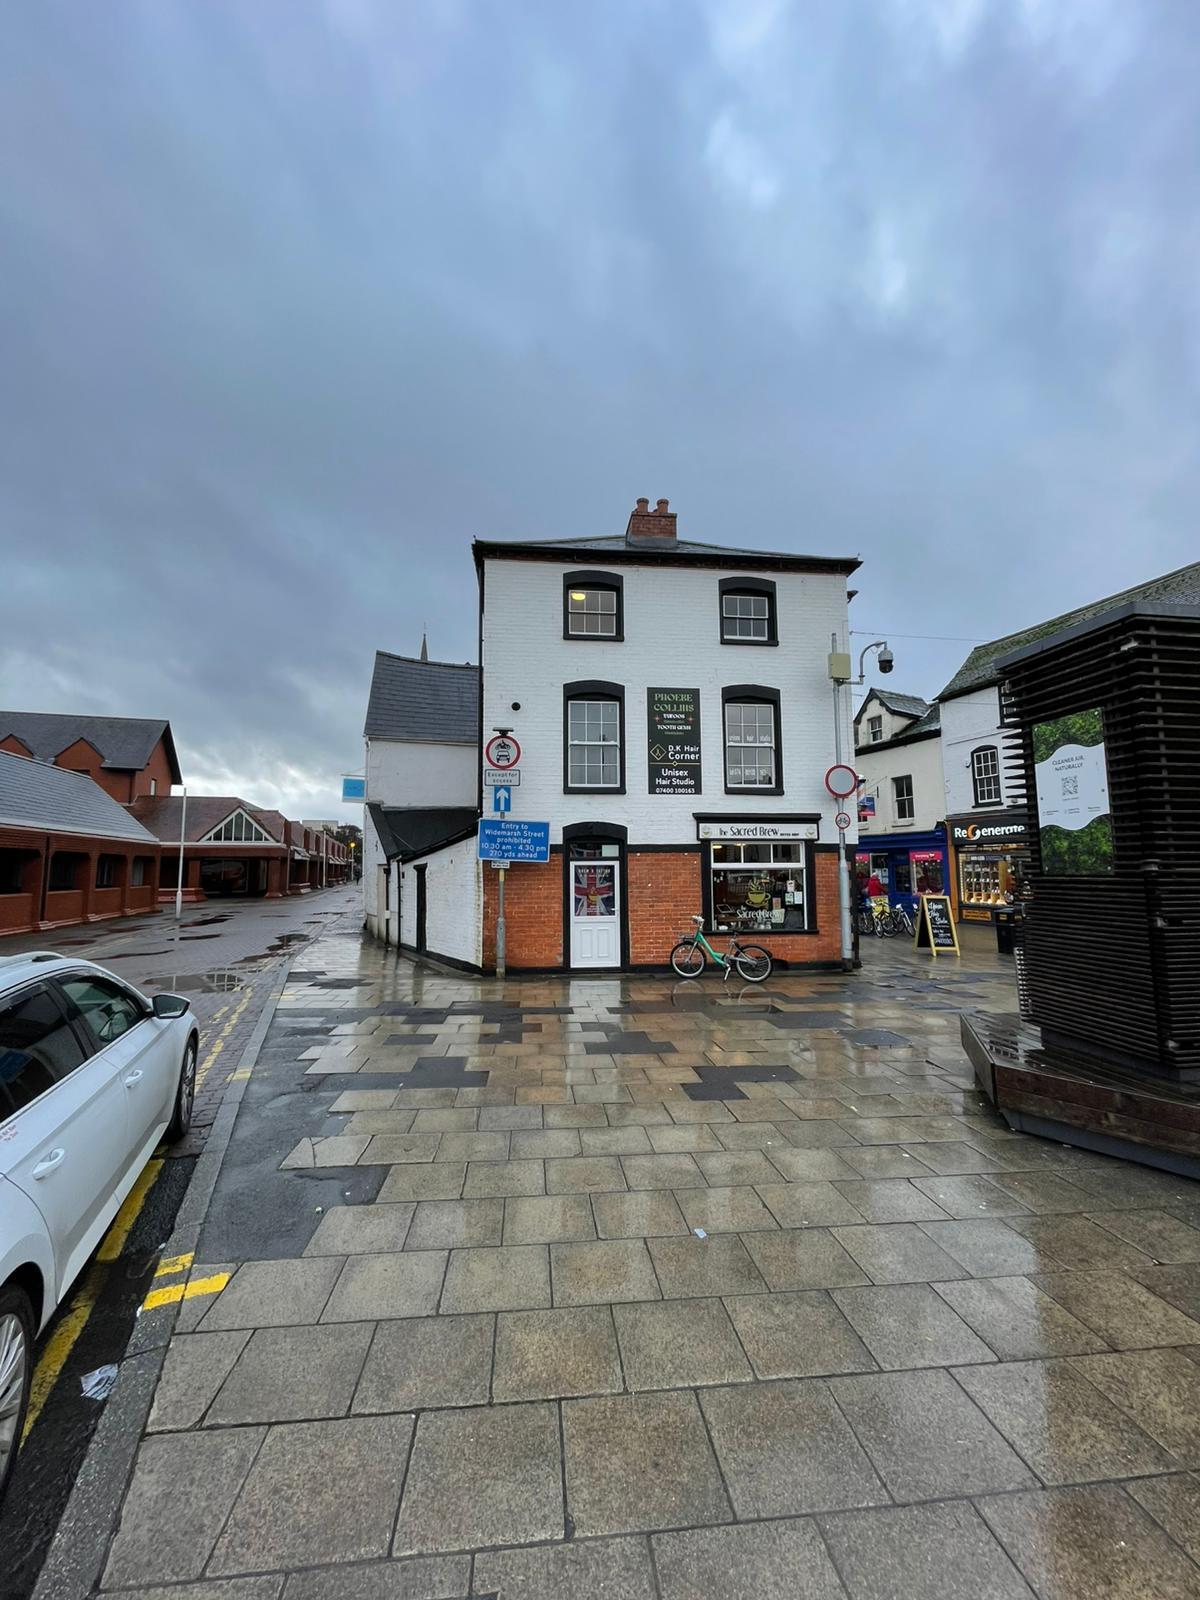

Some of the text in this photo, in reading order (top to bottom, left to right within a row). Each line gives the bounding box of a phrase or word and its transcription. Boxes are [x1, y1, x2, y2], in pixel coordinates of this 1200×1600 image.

[654, 693, 693, 702] PHOEBE
[653, 703, 695, 712] COLLINS
[668, 751, 700, 760] Corner
[1052, 757, 1074, 766] CLEANER
[1055, 762, 1083, 771] NATURALLY
[661, 768, 689, 777] Unisex
[655, 777, 695, 786] Hair Studio
[501, 822, 519, 830] Entry
[484, 828, 544, 838] Widemarsh Street
[729, 825, 758, 837] Sacred
[759, 826, 779, 837] Brew
